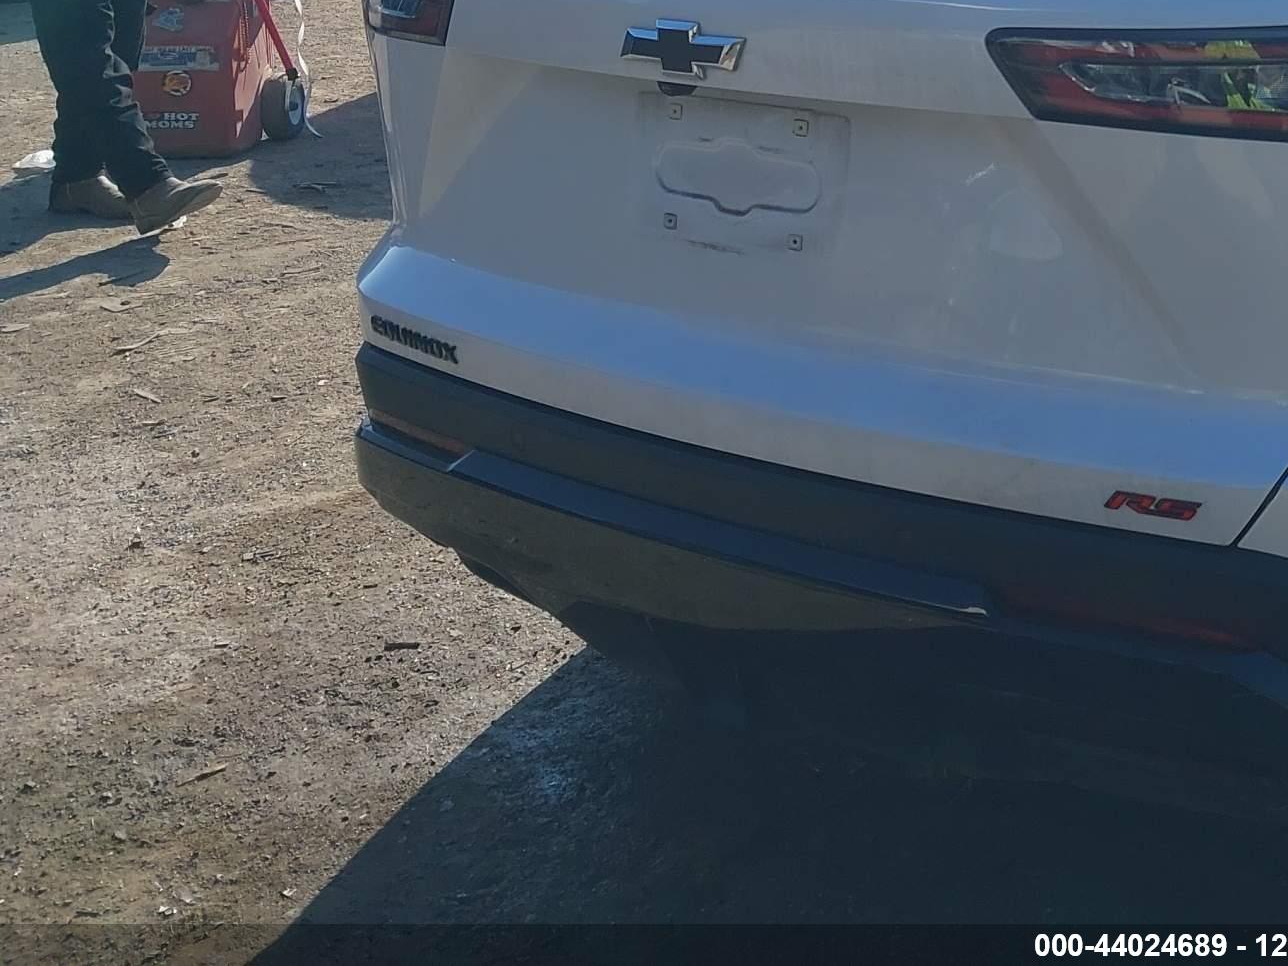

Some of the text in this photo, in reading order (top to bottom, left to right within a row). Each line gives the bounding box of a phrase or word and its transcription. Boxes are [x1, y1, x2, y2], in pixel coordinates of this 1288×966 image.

[144, 120, 194, 129] MOMS
[163, 112, 199, 121] HOT
[370, 314, 459, 364] EQUINOX
[1104, 490, 1202, 521] RS
